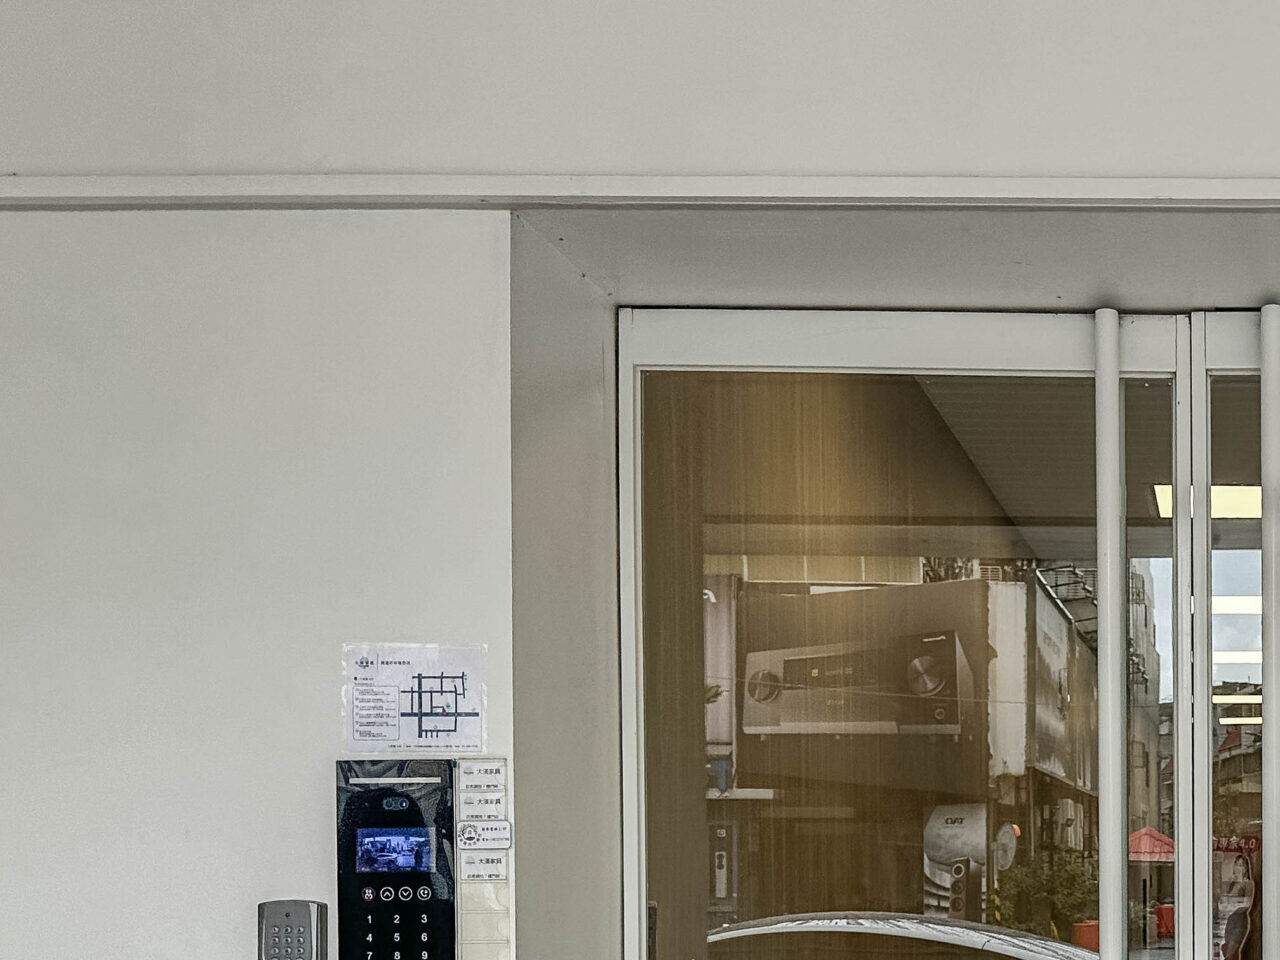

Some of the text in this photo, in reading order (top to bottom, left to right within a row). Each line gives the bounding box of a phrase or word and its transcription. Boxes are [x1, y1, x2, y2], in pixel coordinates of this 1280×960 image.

[367, 915, 427, 924] 1 2 3
[394, 933, 399, 941] 5
[422, 933, 427, 941] 6
[367, 952, 372, 960] 7
[422, 951, 427, 959] 9
